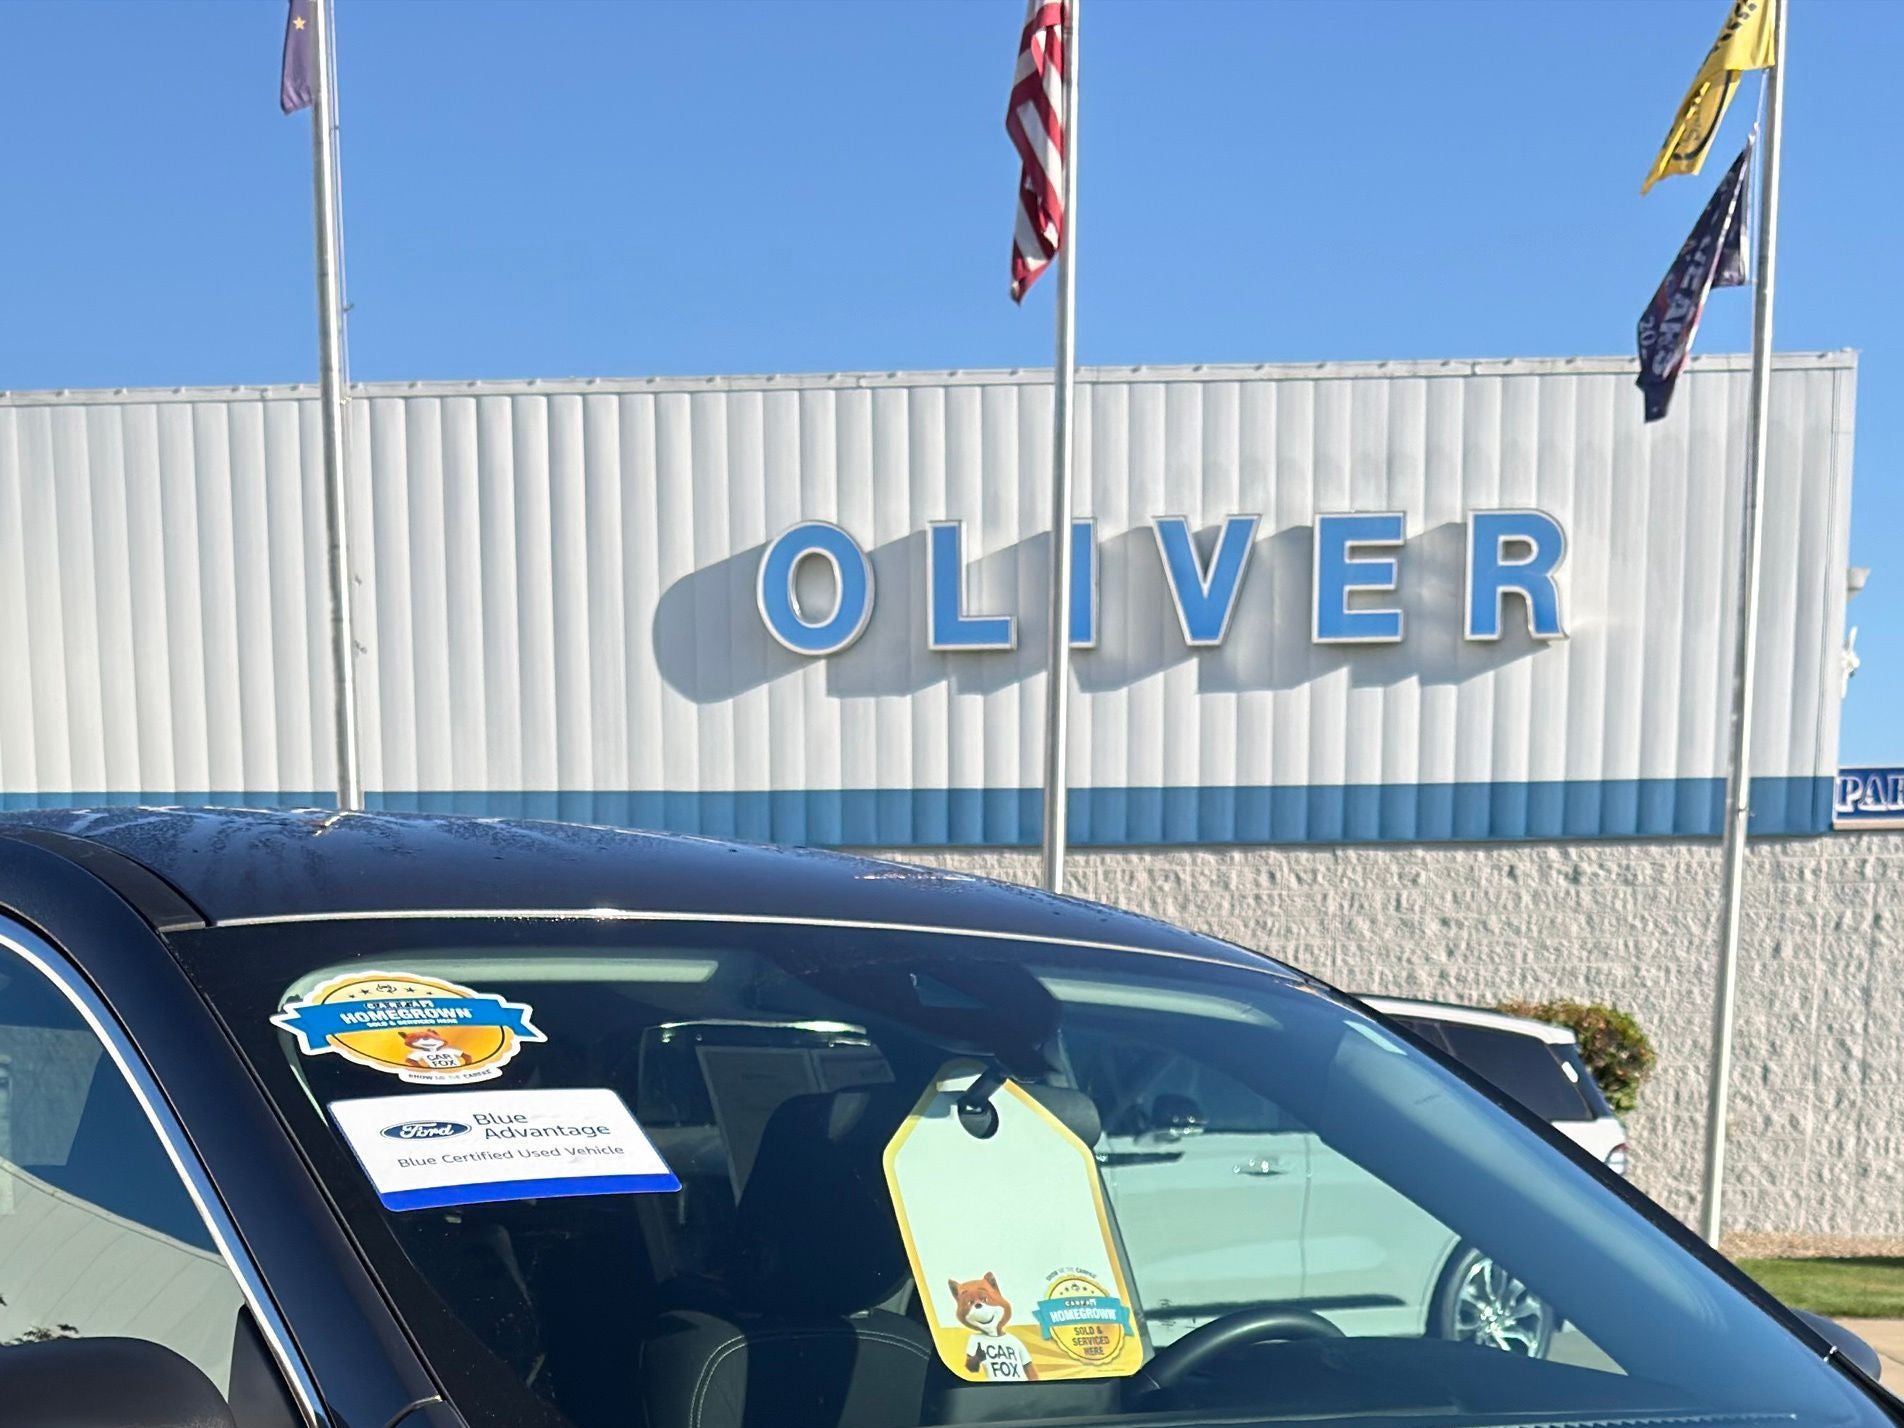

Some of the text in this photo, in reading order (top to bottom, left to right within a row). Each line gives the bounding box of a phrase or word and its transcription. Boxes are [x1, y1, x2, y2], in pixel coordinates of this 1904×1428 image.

[757, 508, 1570, 657] OLIVER
[340, 1007, 472, 1025] HOMEGROWN
[426, 1053, 453, 1063] CAR
[432, 1059, 458, 1067] FOX
[472, 1113, 529, 1126] Blue
[400, 1122, 455, 1139] Ford
[484, 1124, 611, 1140] Advantage
[397, 1144, 625, 1168] Blue Certified Used Vehicle
[1049, 1308, 1117, 1323] HOMEGROWN
[1073, 1326, 1095, 1336] SOLD
[1072, 1336, 1110, 1346] SERVICED
[986, 1344, 1017, 1361] CAR
[1084, 1347, 1105, 1356] HERE
[990, 1361, 1021, 1378] FOX
